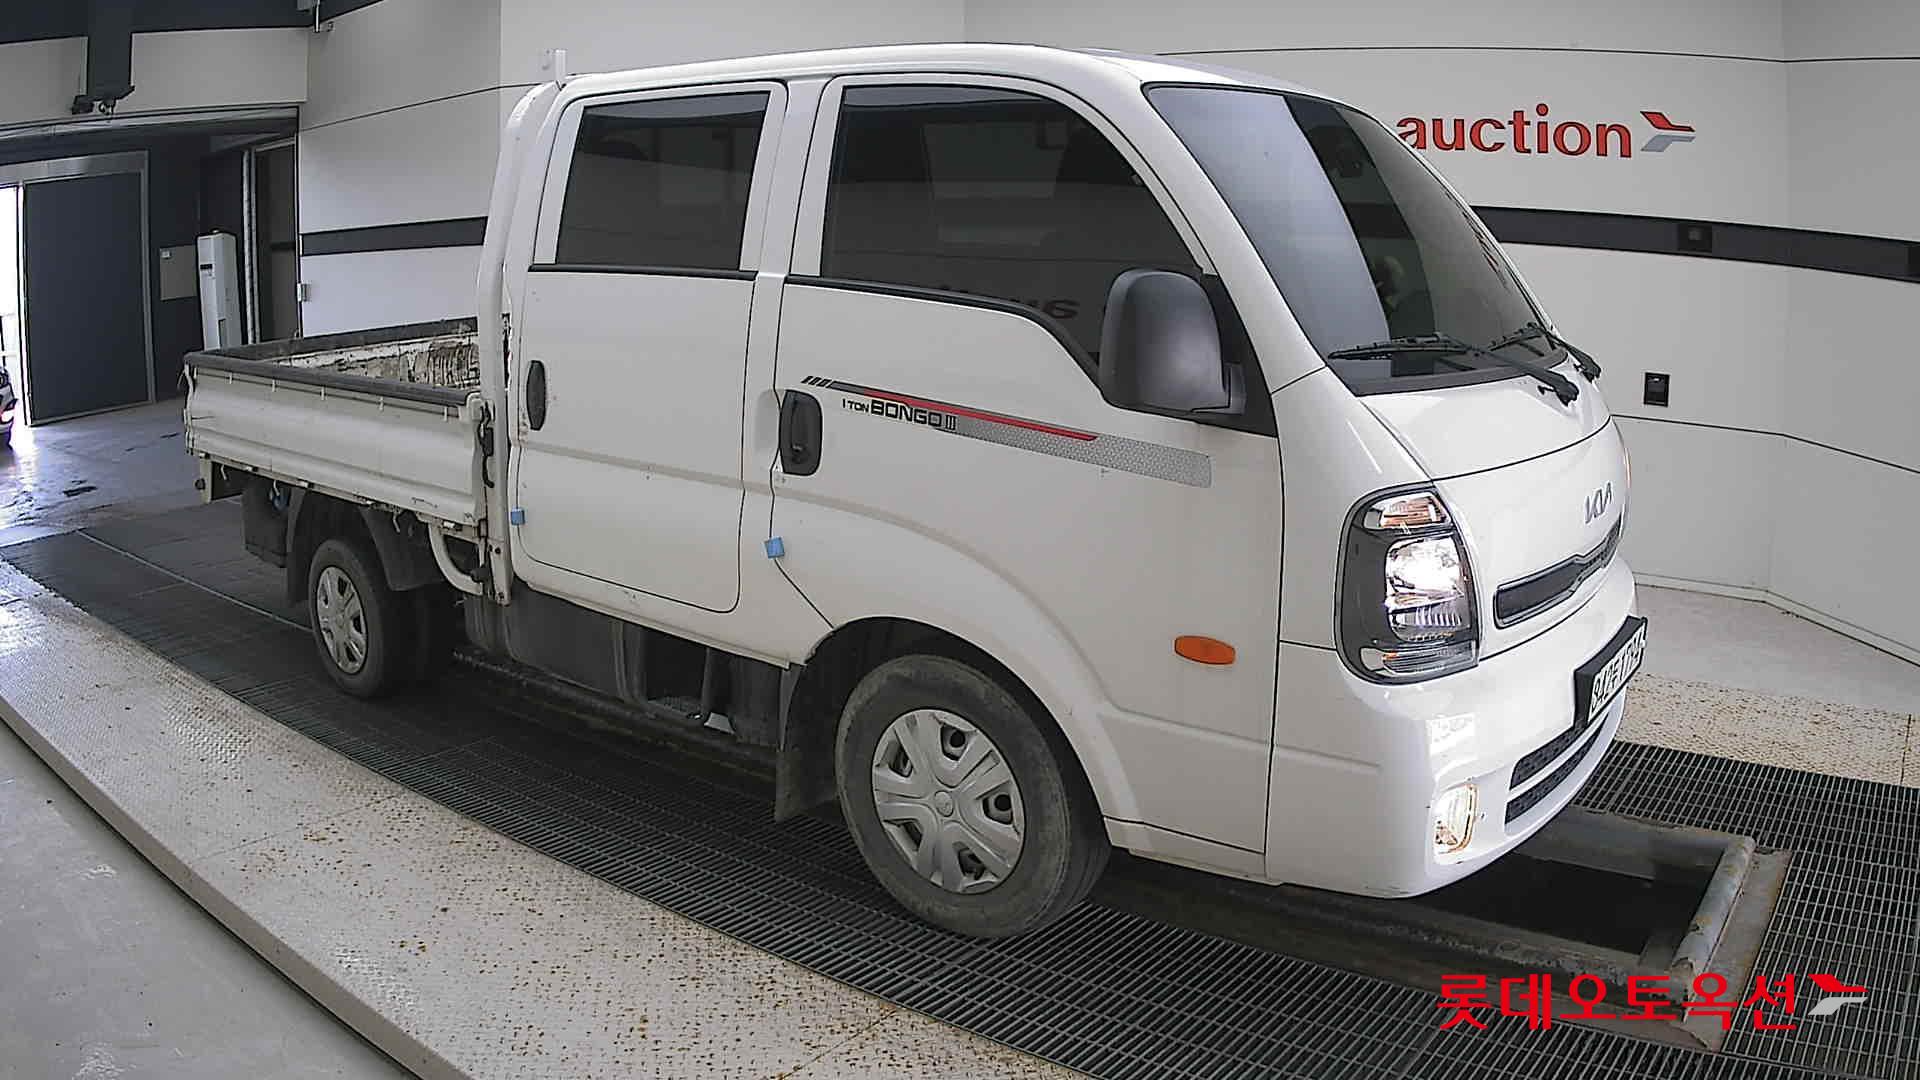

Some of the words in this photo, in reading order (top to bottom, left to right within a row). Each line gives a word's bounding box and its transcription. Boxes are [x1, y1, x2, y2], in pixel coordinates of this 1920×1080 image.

[1397, 103, 1632, 158] auction
[847, 400, 869, 412] TON
[871, 399, 942, 427] BONGO
